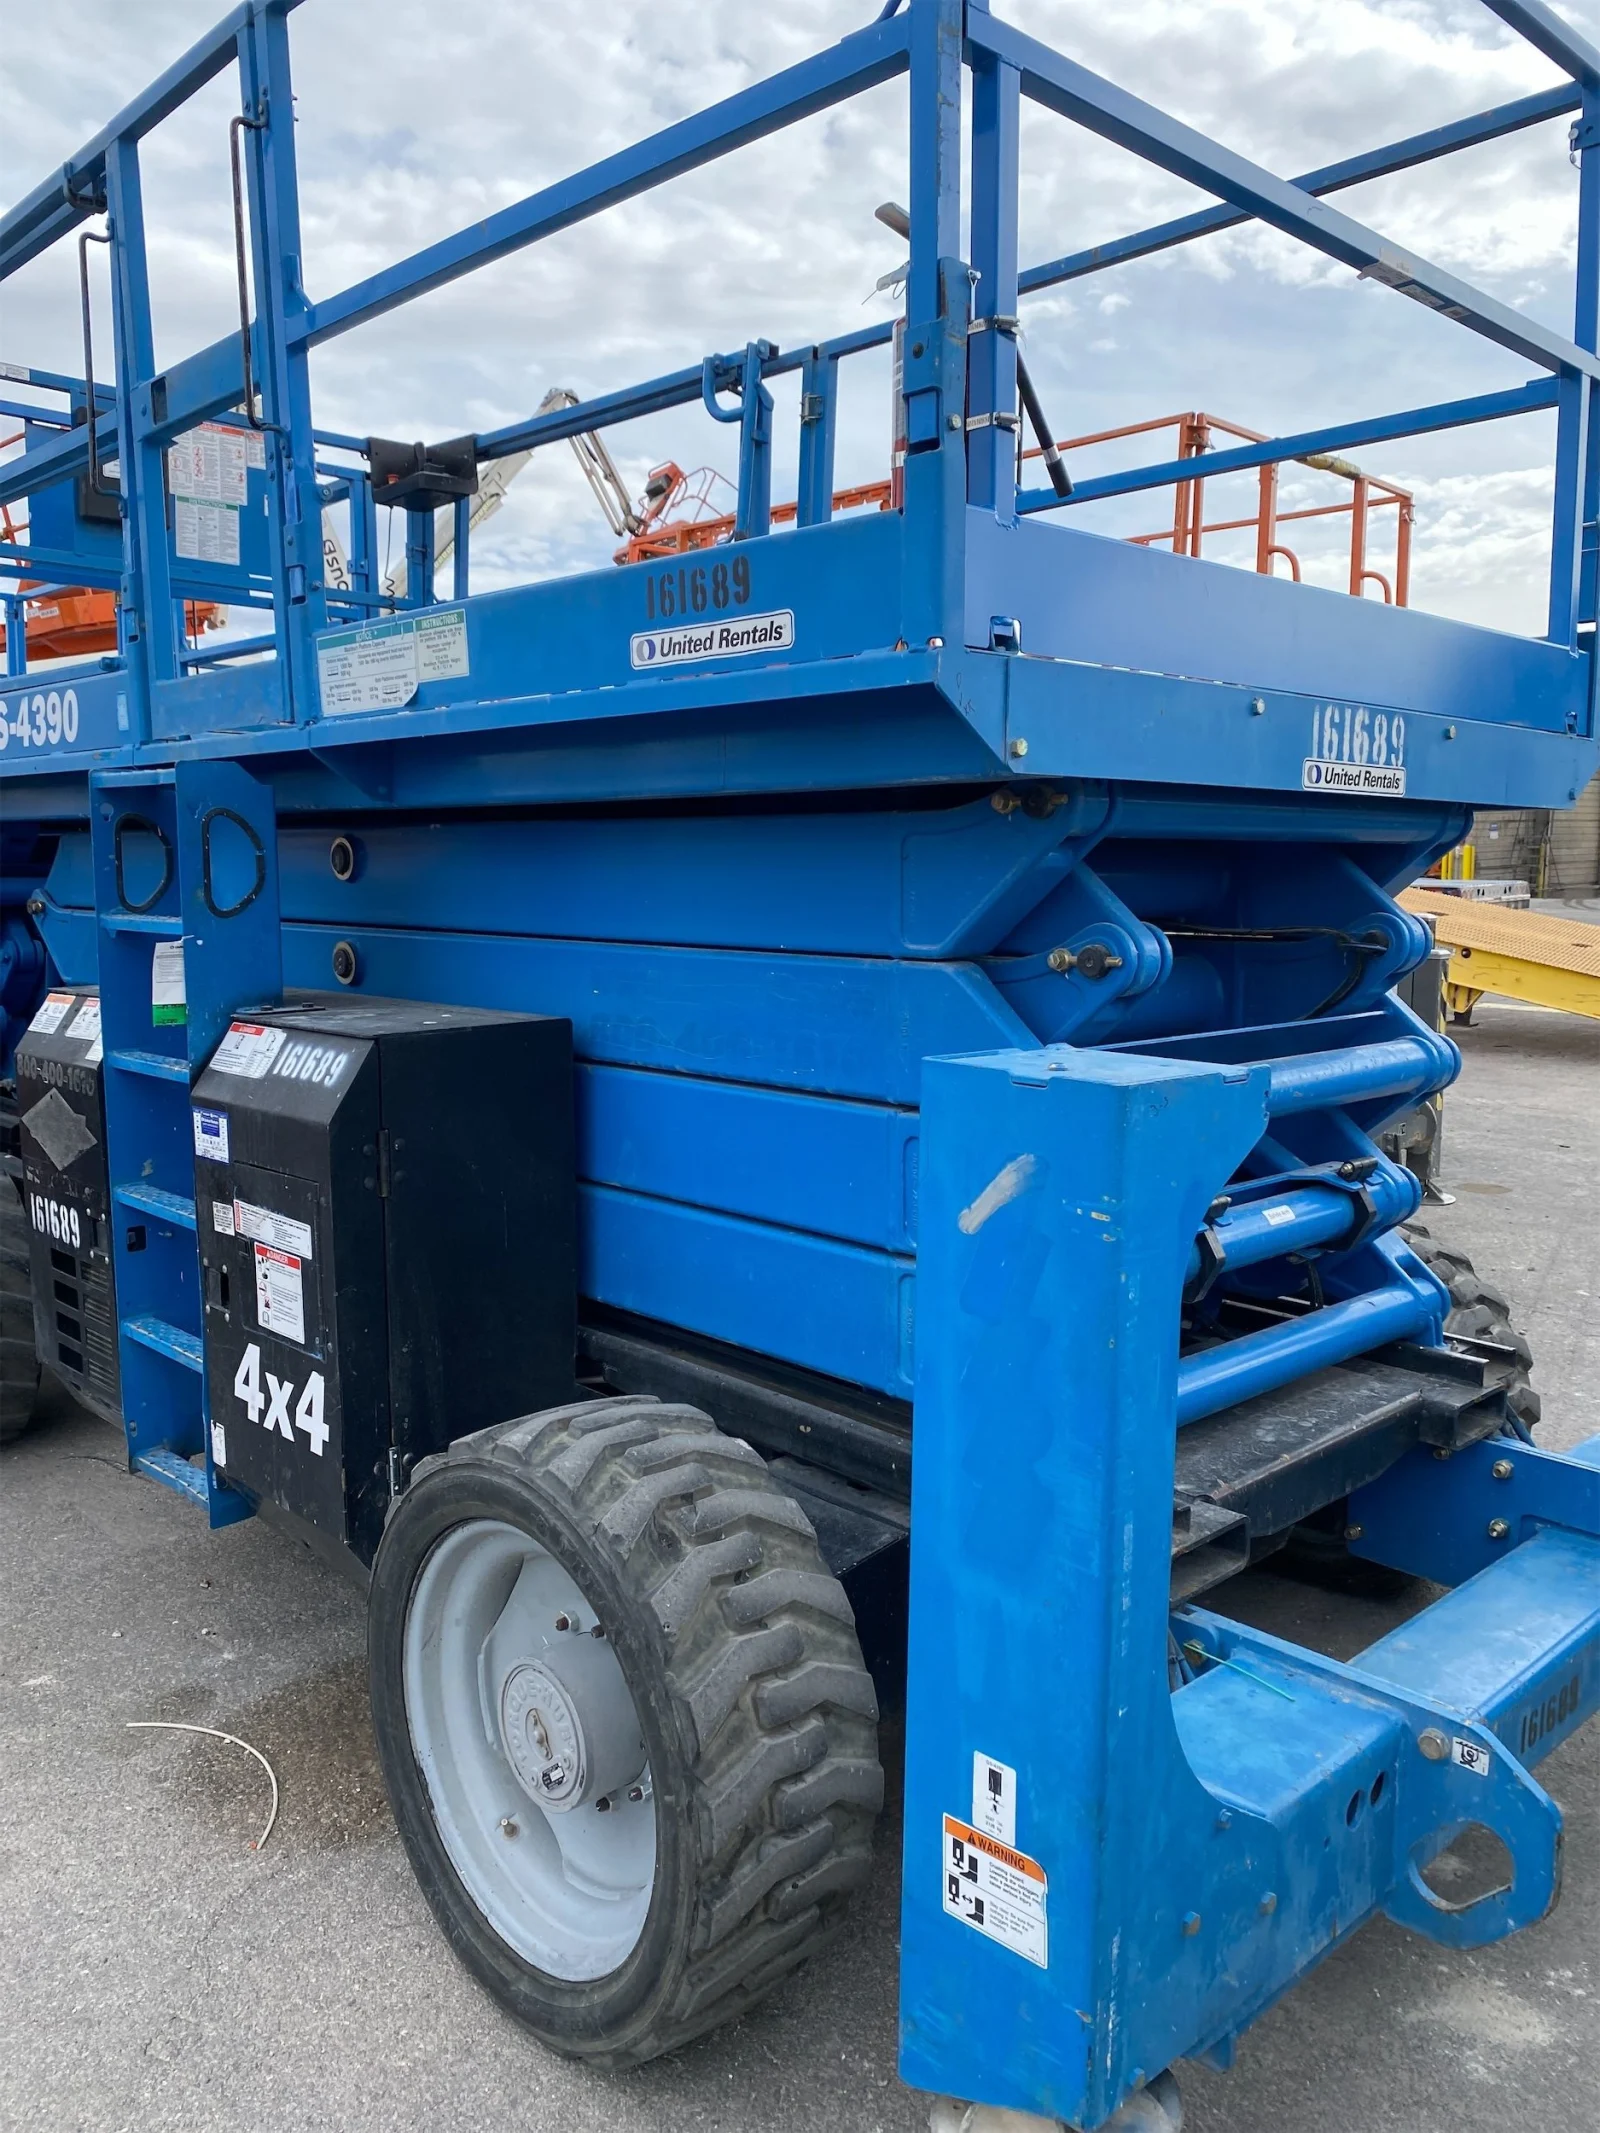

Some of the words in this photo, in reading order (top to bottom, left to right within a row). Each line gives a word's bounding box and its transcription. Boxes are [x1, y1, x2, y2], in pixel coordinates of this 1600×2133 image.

[647, 556, 750, 620] 161689
[422, 613, 458, 629] INSTRUCTIONS
[660, 630, 714, 658] United
[718, 621, 783, 649] Rentals
[1312, 704, 1405, 767] 161689
[1324, 766, 1360, 786] United
[1363, 770, 1400, 790] Rentals
[272, 1042, 348, 1087] 161689
[30, 1192, 81, 1249] 161689
[234, 1342, 330, 1456] 4x4
[1520, 1675, 1580, 1754] 161689
[978, 1836, 1026, 1871] WARNING
